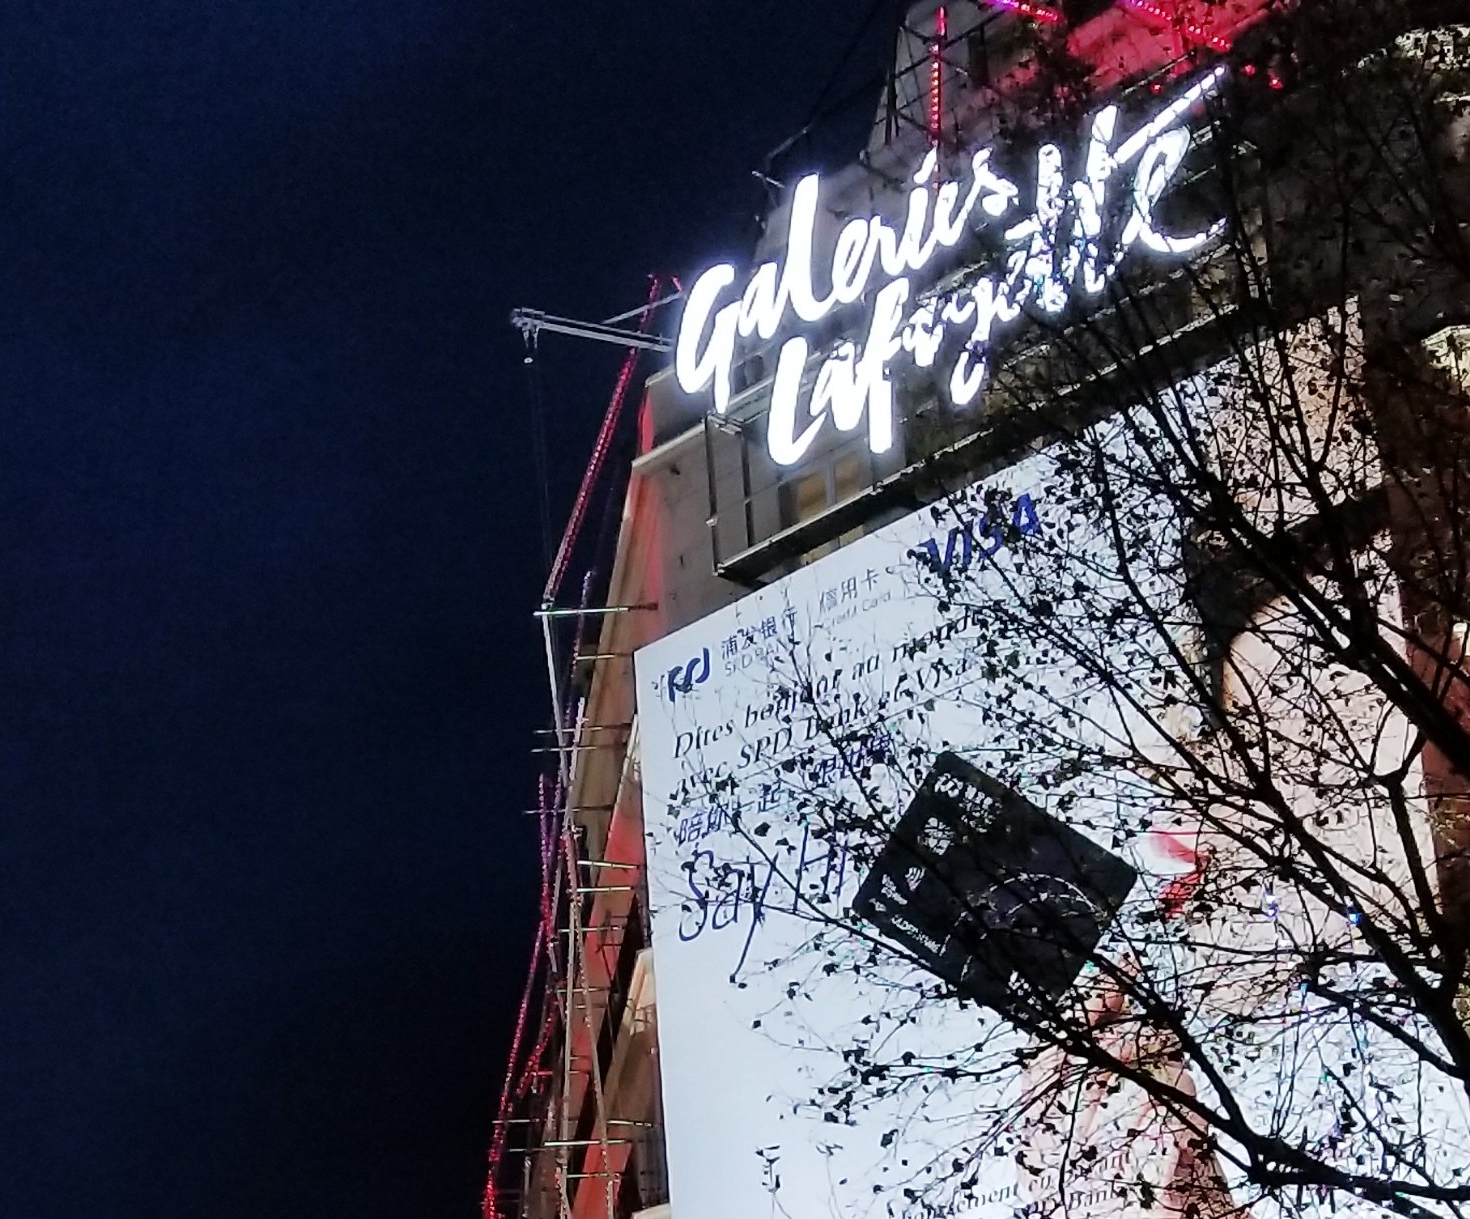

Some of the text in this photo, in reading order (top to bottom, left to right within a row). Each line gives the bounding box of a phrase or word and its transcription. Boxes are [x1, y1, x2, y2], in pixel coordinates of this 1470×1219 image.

[675, 147, 1019, 414] Galeries
[917, 491, 1043, 578] VISA
[673, 717, 734, 758] Dites
[737, 726, 794, 770] SPD
